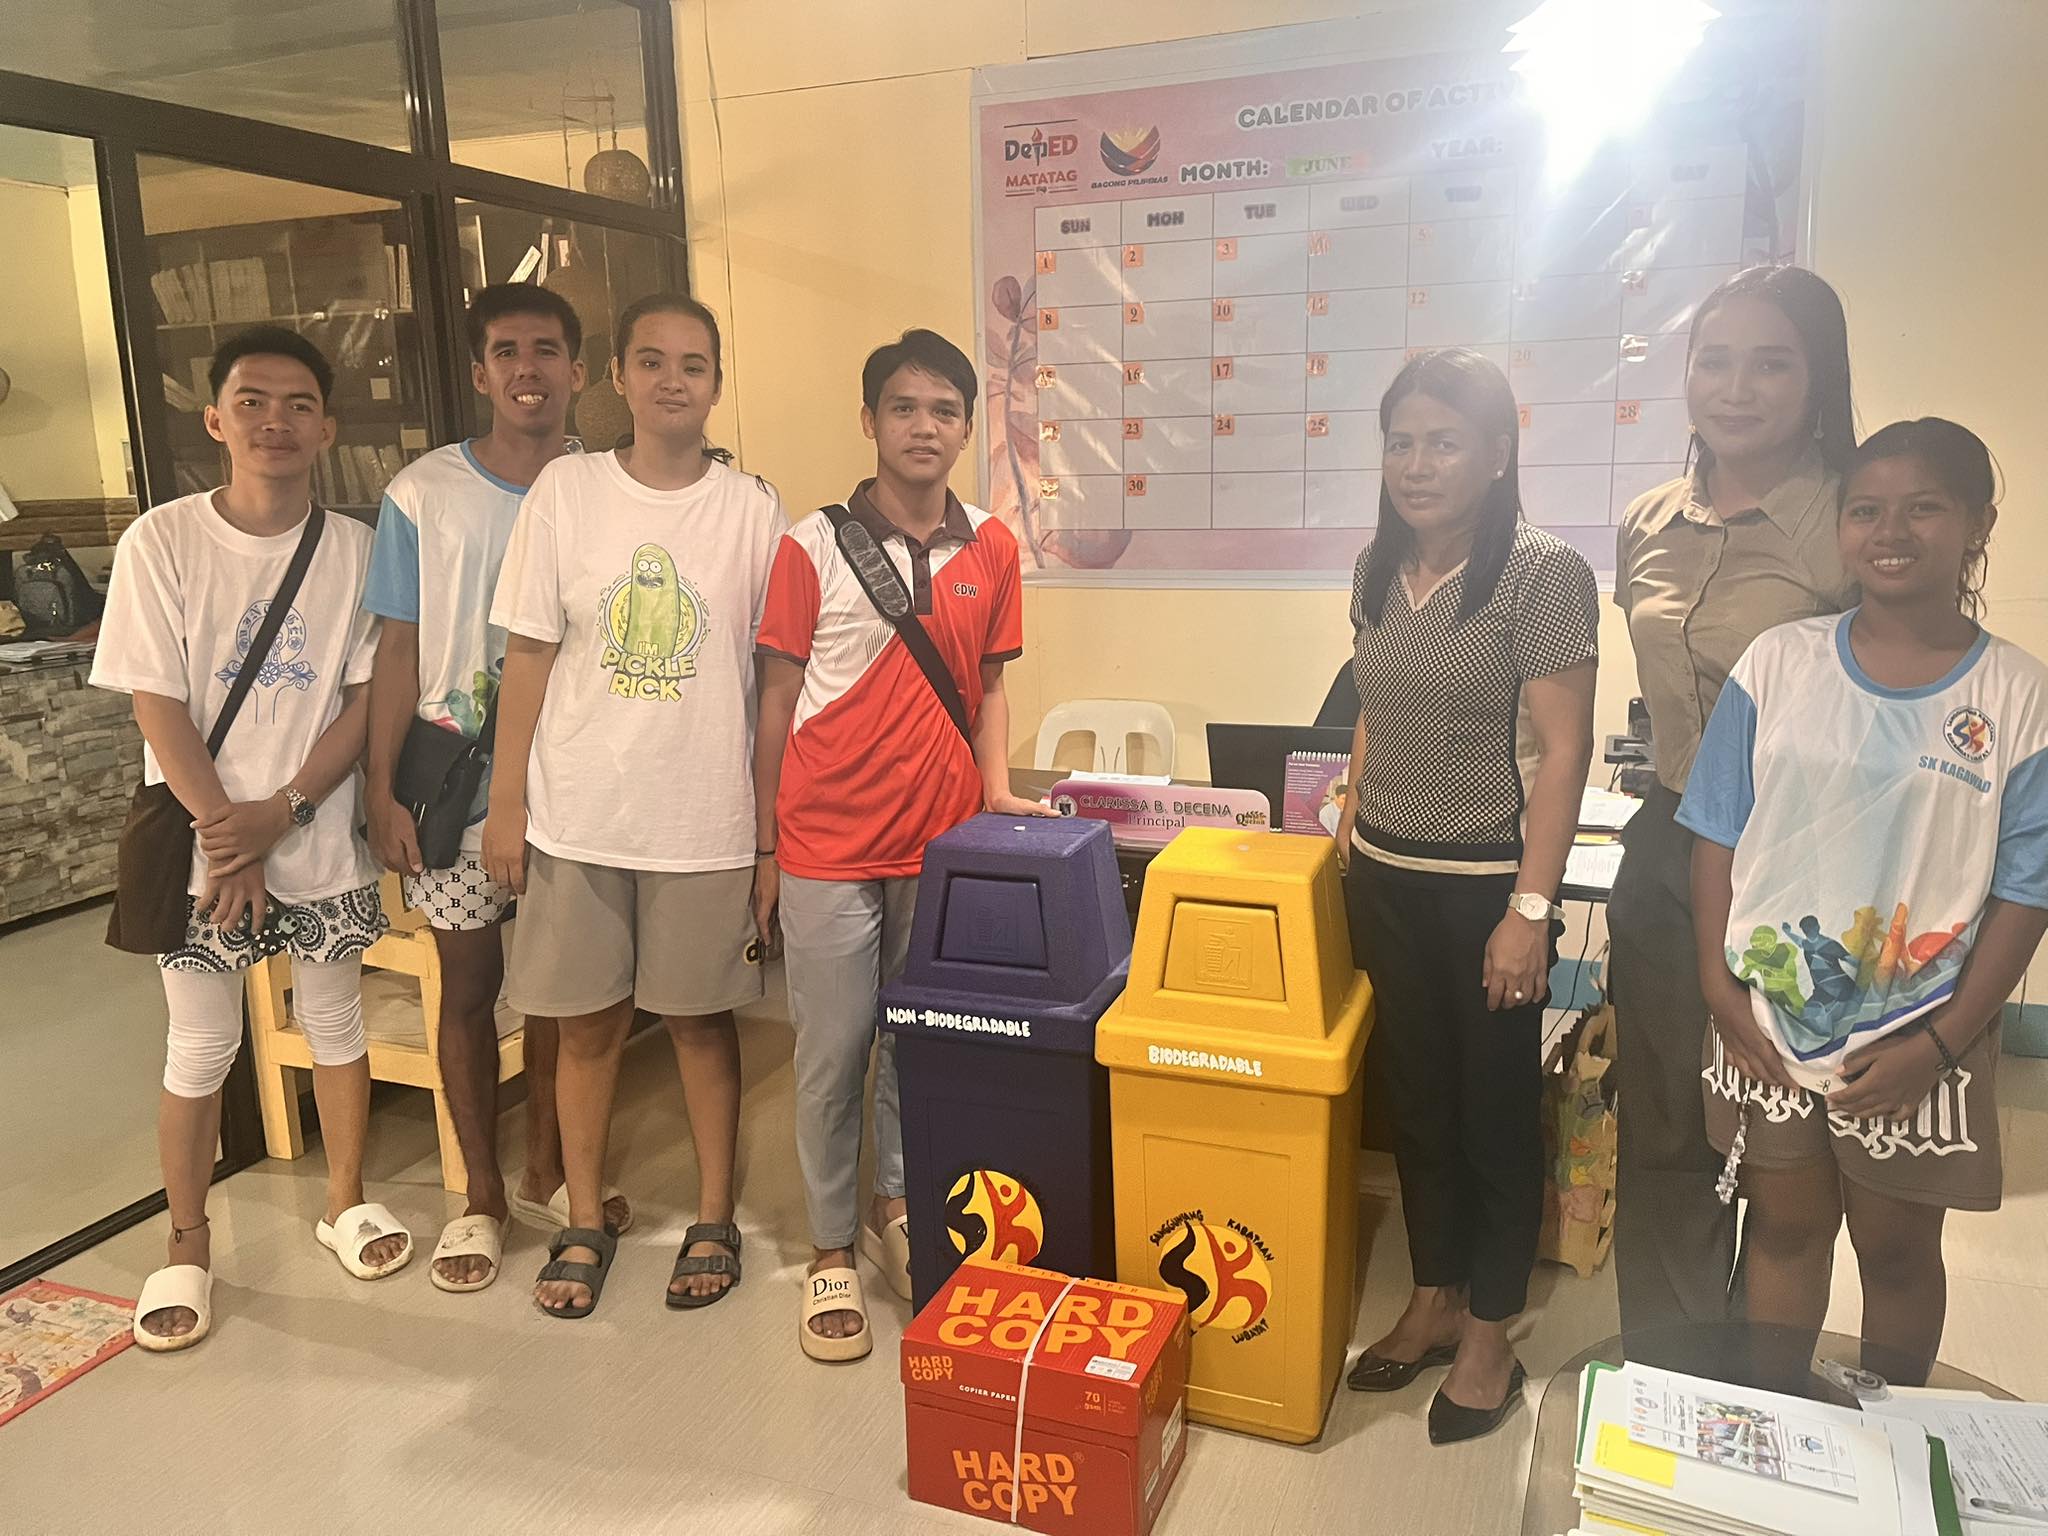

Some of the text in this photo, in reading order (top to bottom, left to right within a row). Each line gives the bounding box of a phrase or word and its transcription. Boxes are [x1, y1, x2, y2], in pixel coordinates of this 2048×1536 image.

[1237, 96, 1379, 129] CALENDAR
[1385, 89, 1424, 113] OF
[1431, 137, 1505, 161] YEAR:
[1178, 157, 1271, 185] MONTH:
[1303, 155, 1352, 174] JUNE
[1005, 169, 1079, 188] MATATAG
[1244, 203, 1277, 220] TUE
[1060, 217, 1092, 235] SUN
[1128, 250, 1137, 263] 2
[1222, 243, 1230, 256] 3
[1411, 291, 1426, 305] 12
[1130, 307, 1138, 323] 9
[1217, 304, 1231, 317] 10
[1044, 313, 1053, 326] 8
[1216, 363, 1231, 377] 17
[1310, 359, 1325, 373] 18
[1127, 368, 1140, 382] 16
[1619, 405, 1638, 419] 28
[1126, 422, 1140, 436] 23
[1216, 418, 1231, 432] 24
[1309, 419, 1326, 433] 25
[1128, 480, 1144, 493] 30
[953, 583, 978, 598] CDW
[637, 640, 660, 657] I'M
[600, 646, 697, 679] PICKLE
[608, 672, 682, 702] RICK
[1918, 755, 1938, 771] SK
[1079, 793, 1150, 812] CLARISSA
[1153, 800, 1169, 814] B.
[1173, 801, 1234, 818] DECENA
[1128, 814, 1186, 830] Principal
[886, 1006, 1031, 1038] NON-BIODEGRADABLE
[1147, 1044, 1263, 1077] BIODEGRADABLE
[1226, 1218, 1275, 1262] KABATAAN
[812, 1278, 850, 1298] Dior
[945, 1286, 1155, 1328] HARD
[937, 1314, 1150, 1360] COPY
[1231, 1317, 1270, 1345] LUBAYAT
[908, 1355, 953, 1369] HARD
[911, 1368, 954, 1382] COPY
[959, 1384, 1017, 1403] COPIER PAPER
[1084, 1390, 1101, 1404] 70
[952, 1450, 1076, 1484] HARD
[962, 1481, 1078, 1516] COPY
